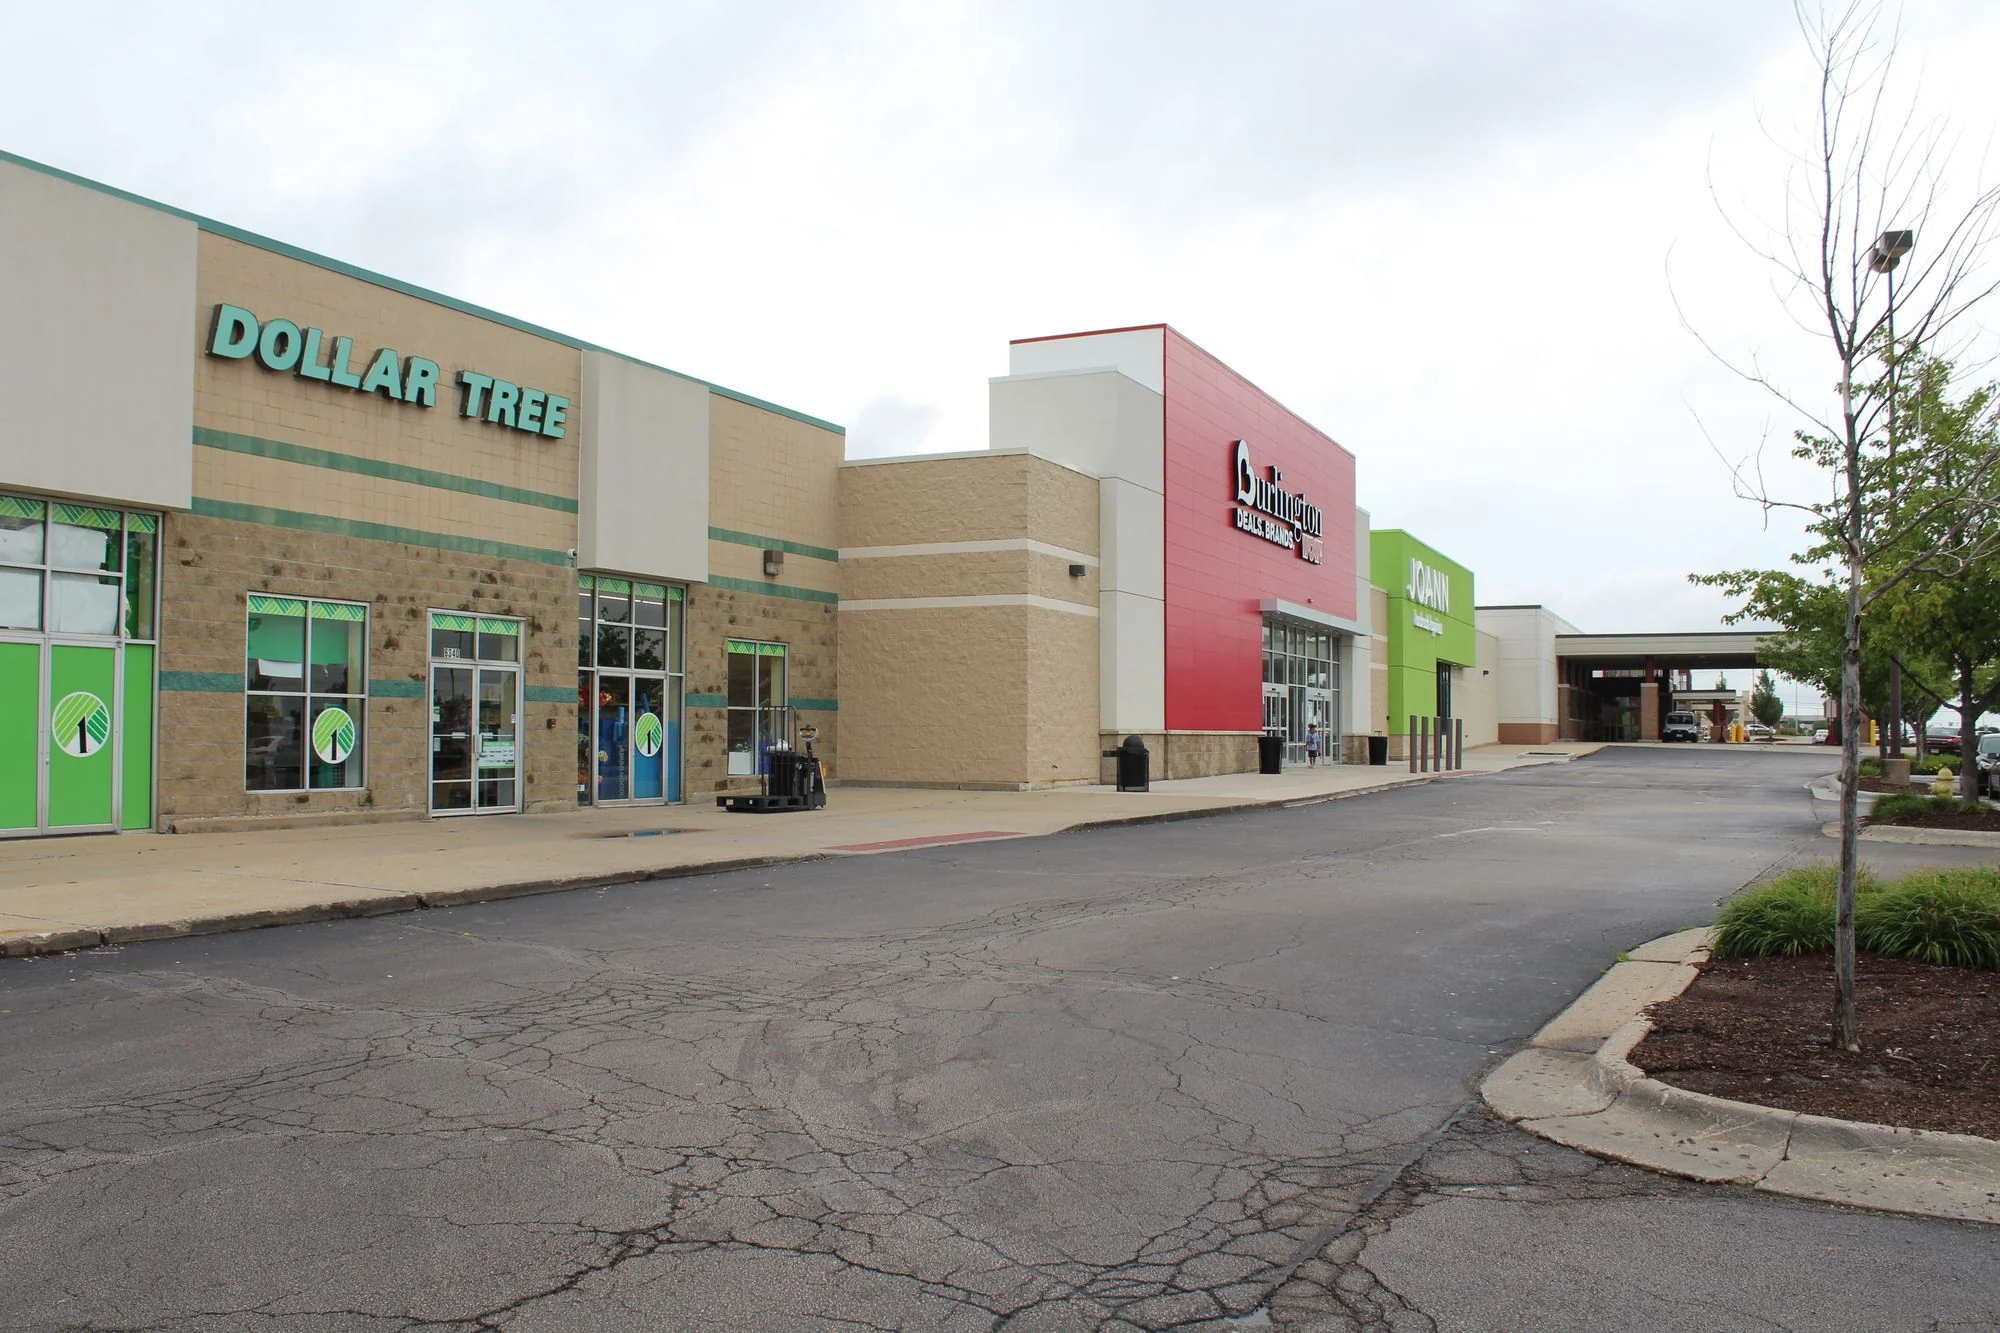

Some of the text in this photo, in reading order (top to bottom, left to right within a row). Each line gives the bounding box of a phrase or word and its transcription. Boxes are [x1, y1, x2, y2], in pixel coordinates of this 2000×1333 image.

[206, 303, 570, 440] DOLLAR TREE
[1234, 439, 1323, 543] Burlington
[1235, 507, 1265, 538] DEALS.
[1265, 520, 1295, 550] BRANDS.
[1407, 556, 1449, 613] JOANN
